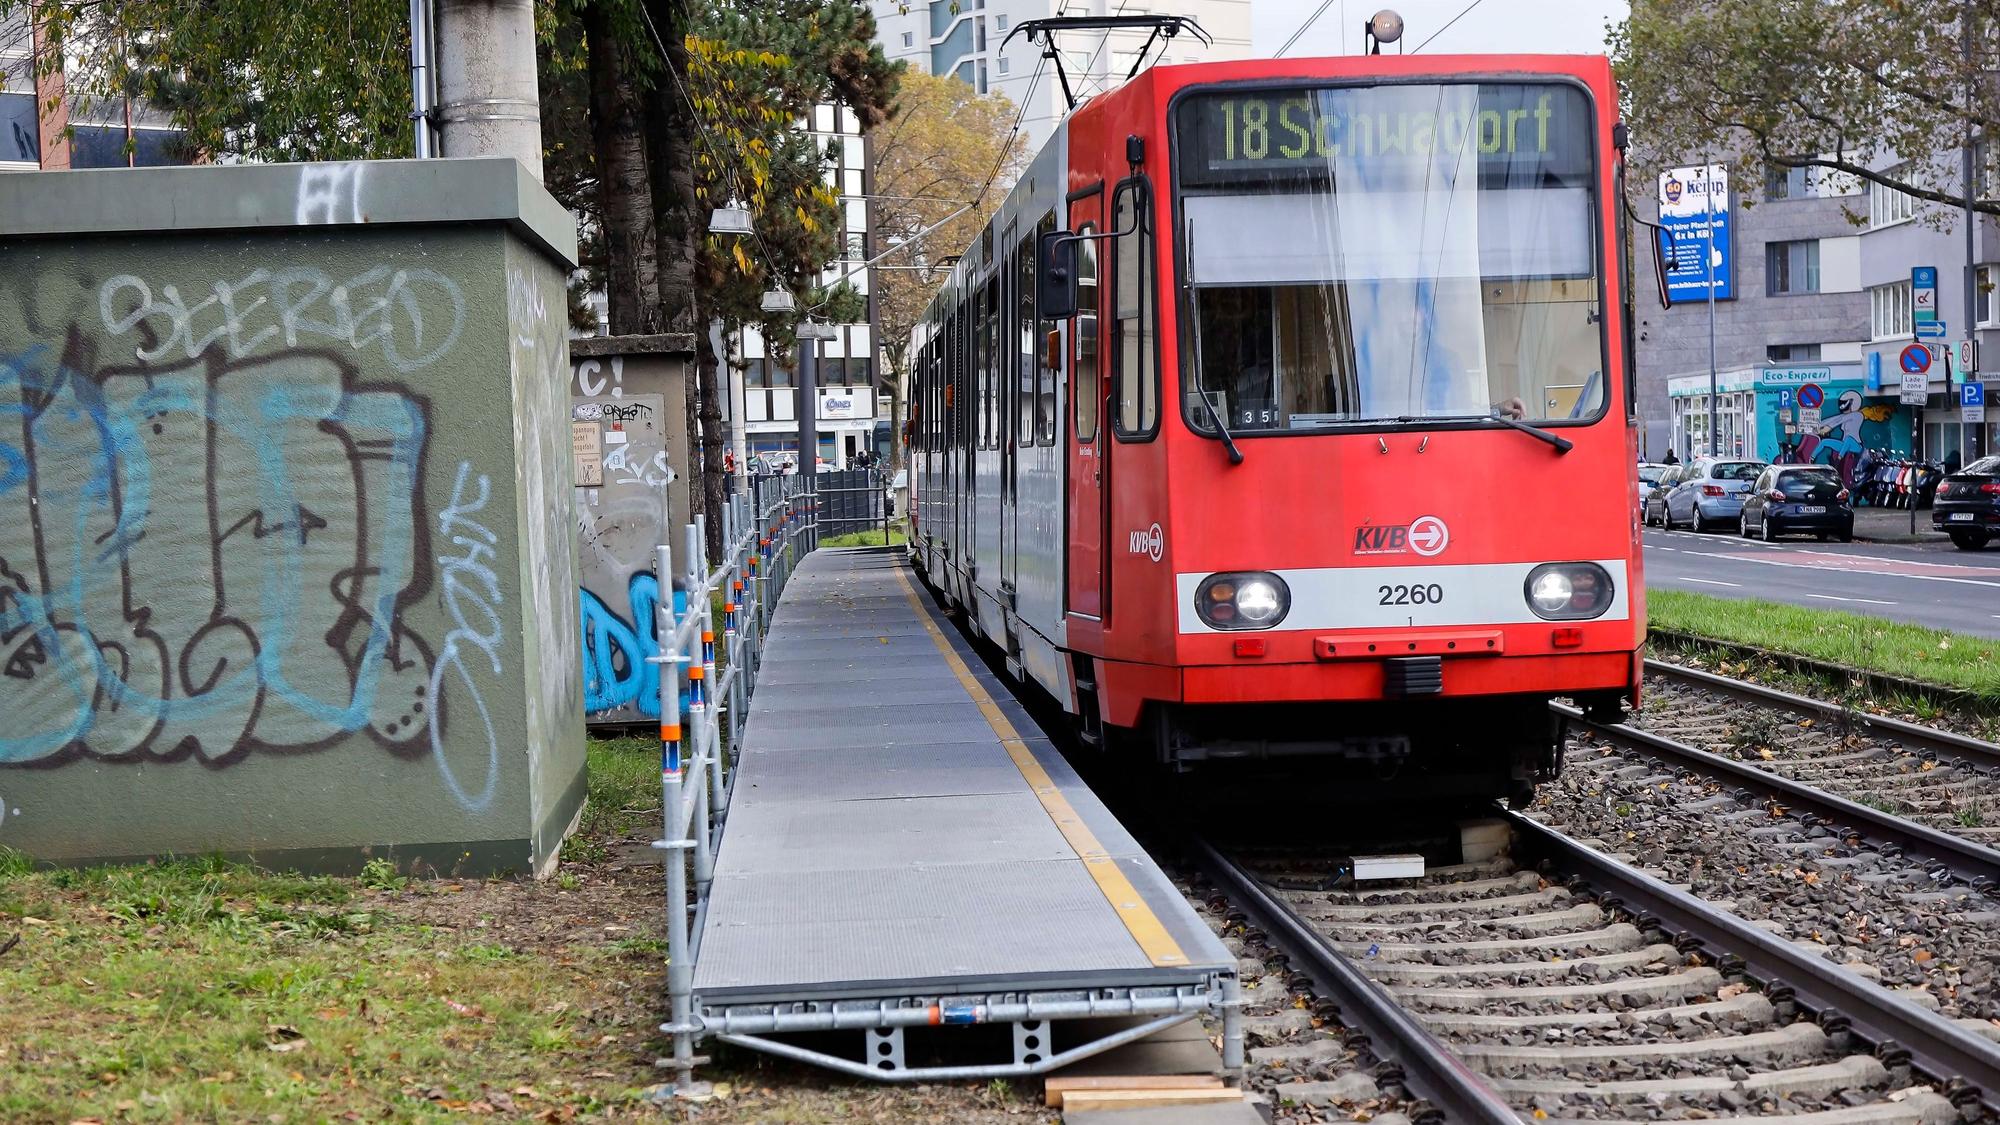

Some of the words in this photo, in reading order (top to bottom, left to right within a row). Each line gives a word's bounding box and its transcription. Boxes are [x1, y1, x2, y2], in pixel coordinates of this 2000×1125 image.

[1221, 99, 1268, 160] 18
[1279, 93, 1552, 160] Schwadorf
[1667, 182, 1680, 192] 60
[1765, 370, 1827, 381] Eco-Express
[1781, 390, 1789, 406] P
[1965, 385, 1977, 403] P
[1129, 531, 1149, 553] KVB
[1354, 526, 1408, 550] KVB
[1378, 583, 1444, 606] 2260
